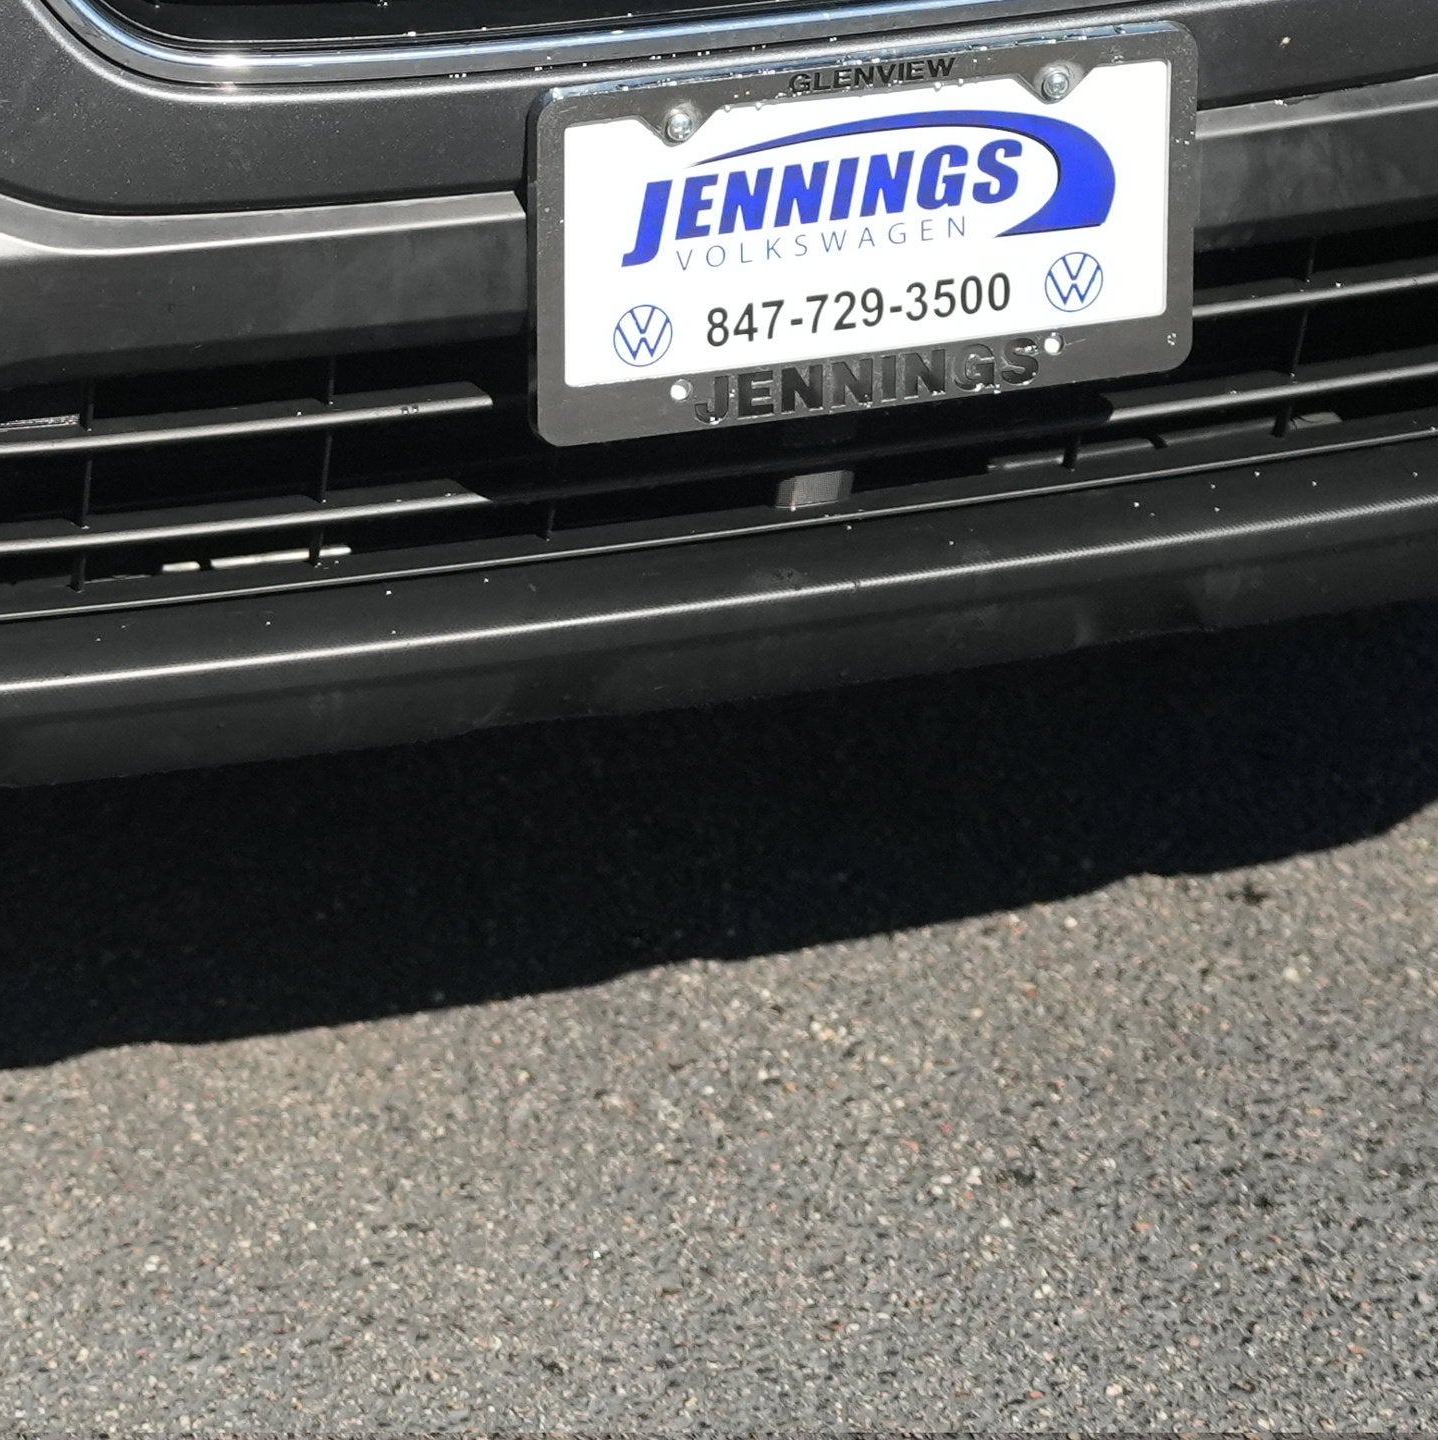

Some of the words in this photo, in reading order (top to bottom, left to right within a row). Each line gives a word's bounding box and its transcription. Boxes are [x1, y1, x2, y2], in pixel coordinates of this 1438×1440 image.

[789, 56, 956, 95] GLENVIEW
[622, 137, 1024, 267] JENNINGS
[676, 215, 967, 271] VOLKSWAGEN
[706, 272, 1011, 348] 847-729-3500
[695, 337, 1039, 424] JENNINGS
